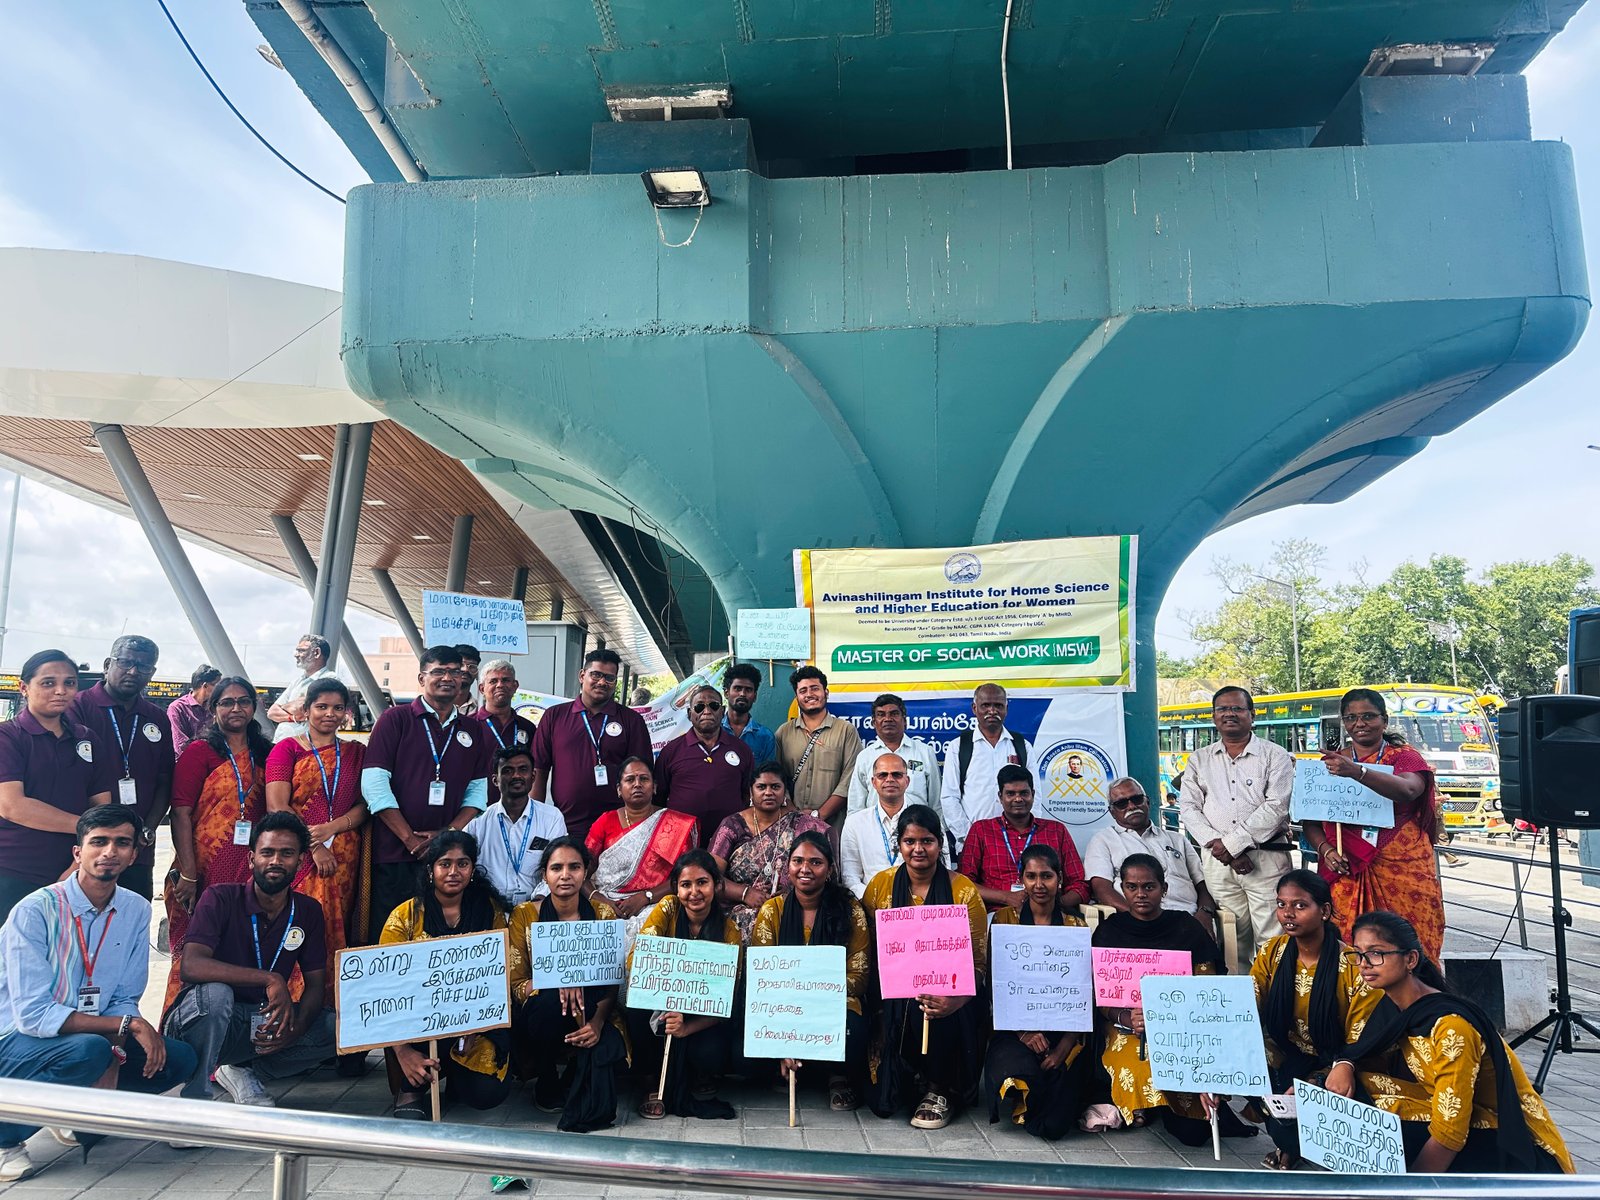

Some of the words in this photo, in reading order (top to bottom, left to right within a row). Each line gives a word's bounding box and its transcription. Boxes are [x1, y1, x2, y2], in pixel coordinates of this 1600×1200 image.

[822, 591, 922, 603] Avinashilingam
[926, 588, 984, 600] Institute
[987, 587, 1007, 597] for
[1011, 586, 1050, 596] Home
[1054, 583, 1110, 594] Science
[855, 604, 879, 614] and
[883, 603, 927, 615] Higher
[931, 601, 999, 613] Education
[1003, 599, 1022, 608] for
[1026, 598, 1075, 607] Women
[837, 649, 904, 664] MASTER
[908, 649, 932, 663] OF
[937, 647, 994, 661] SOCIAL
[999, 644, 1051, 659] WORK
[1048, 799, 1084, 807] Empowerment
[536, 922, 570, 940] உதவி
[340, 951, 413, 981] இன்று
[428, 937, 501, 969] கண்ணீர்
[1005, 942, 1033, 961] ஒரு
[532, 955, 555, 973] அது
[422, 962, 506, 988] இருக்கலாம்
[359, 995, 415, 1027] நாளை
[431, 982, 489, 1009] நிச்சயம்
[1159, 989, 1186, 1009] ஒரு
[422, 1008, 471, 1033] விடியல்
